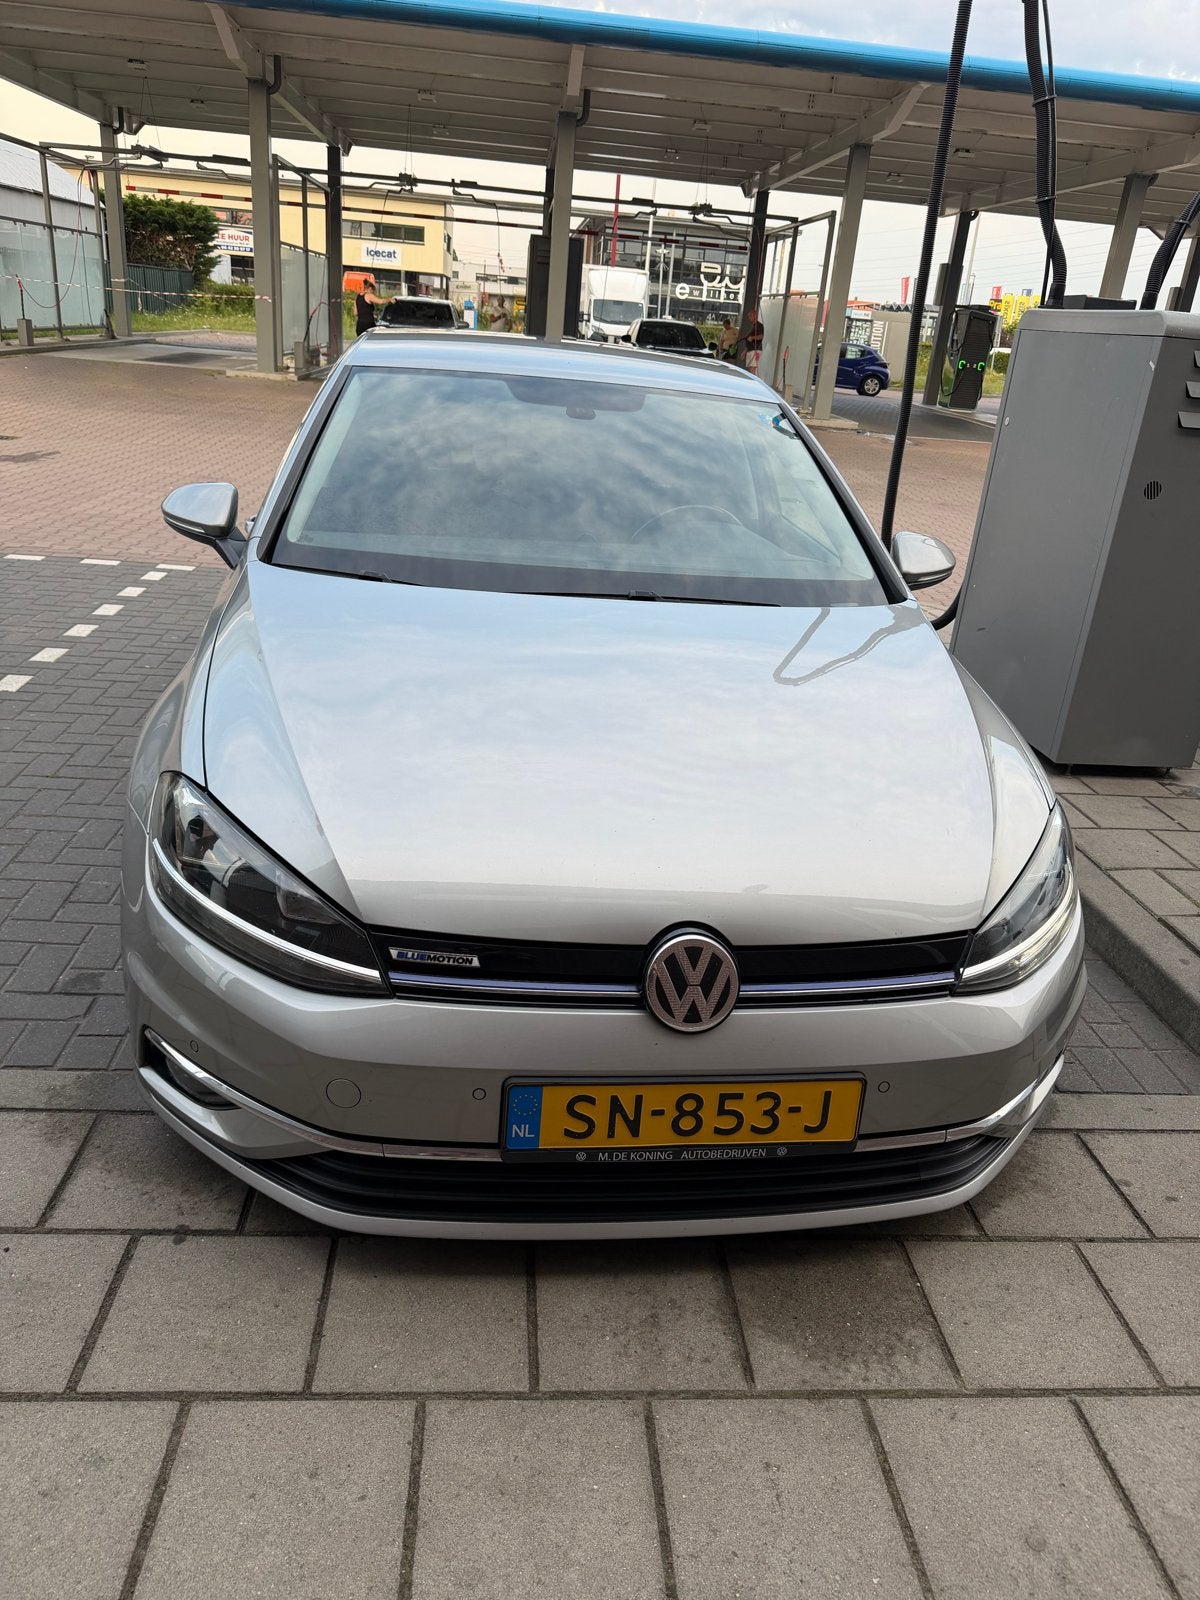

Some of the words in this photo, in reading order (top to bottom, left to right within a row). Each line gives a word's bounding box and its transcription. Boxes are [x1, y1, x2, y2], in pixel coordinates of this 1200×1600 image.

[227, 233, 250, 242] HUUR
[871, 320, 884, 350] UTION
[397, 951, 474, 965] BLUEMOTION
[563, 1090, 832, 1139] SN-853-J
[511, 1124, 535, 1138] NL
[613, 1152, 628, 1161] DE
[630, 1151, 673, 1161] KONING
[680, 1148, 767, 1160] AUTOBEDRIJVEN
